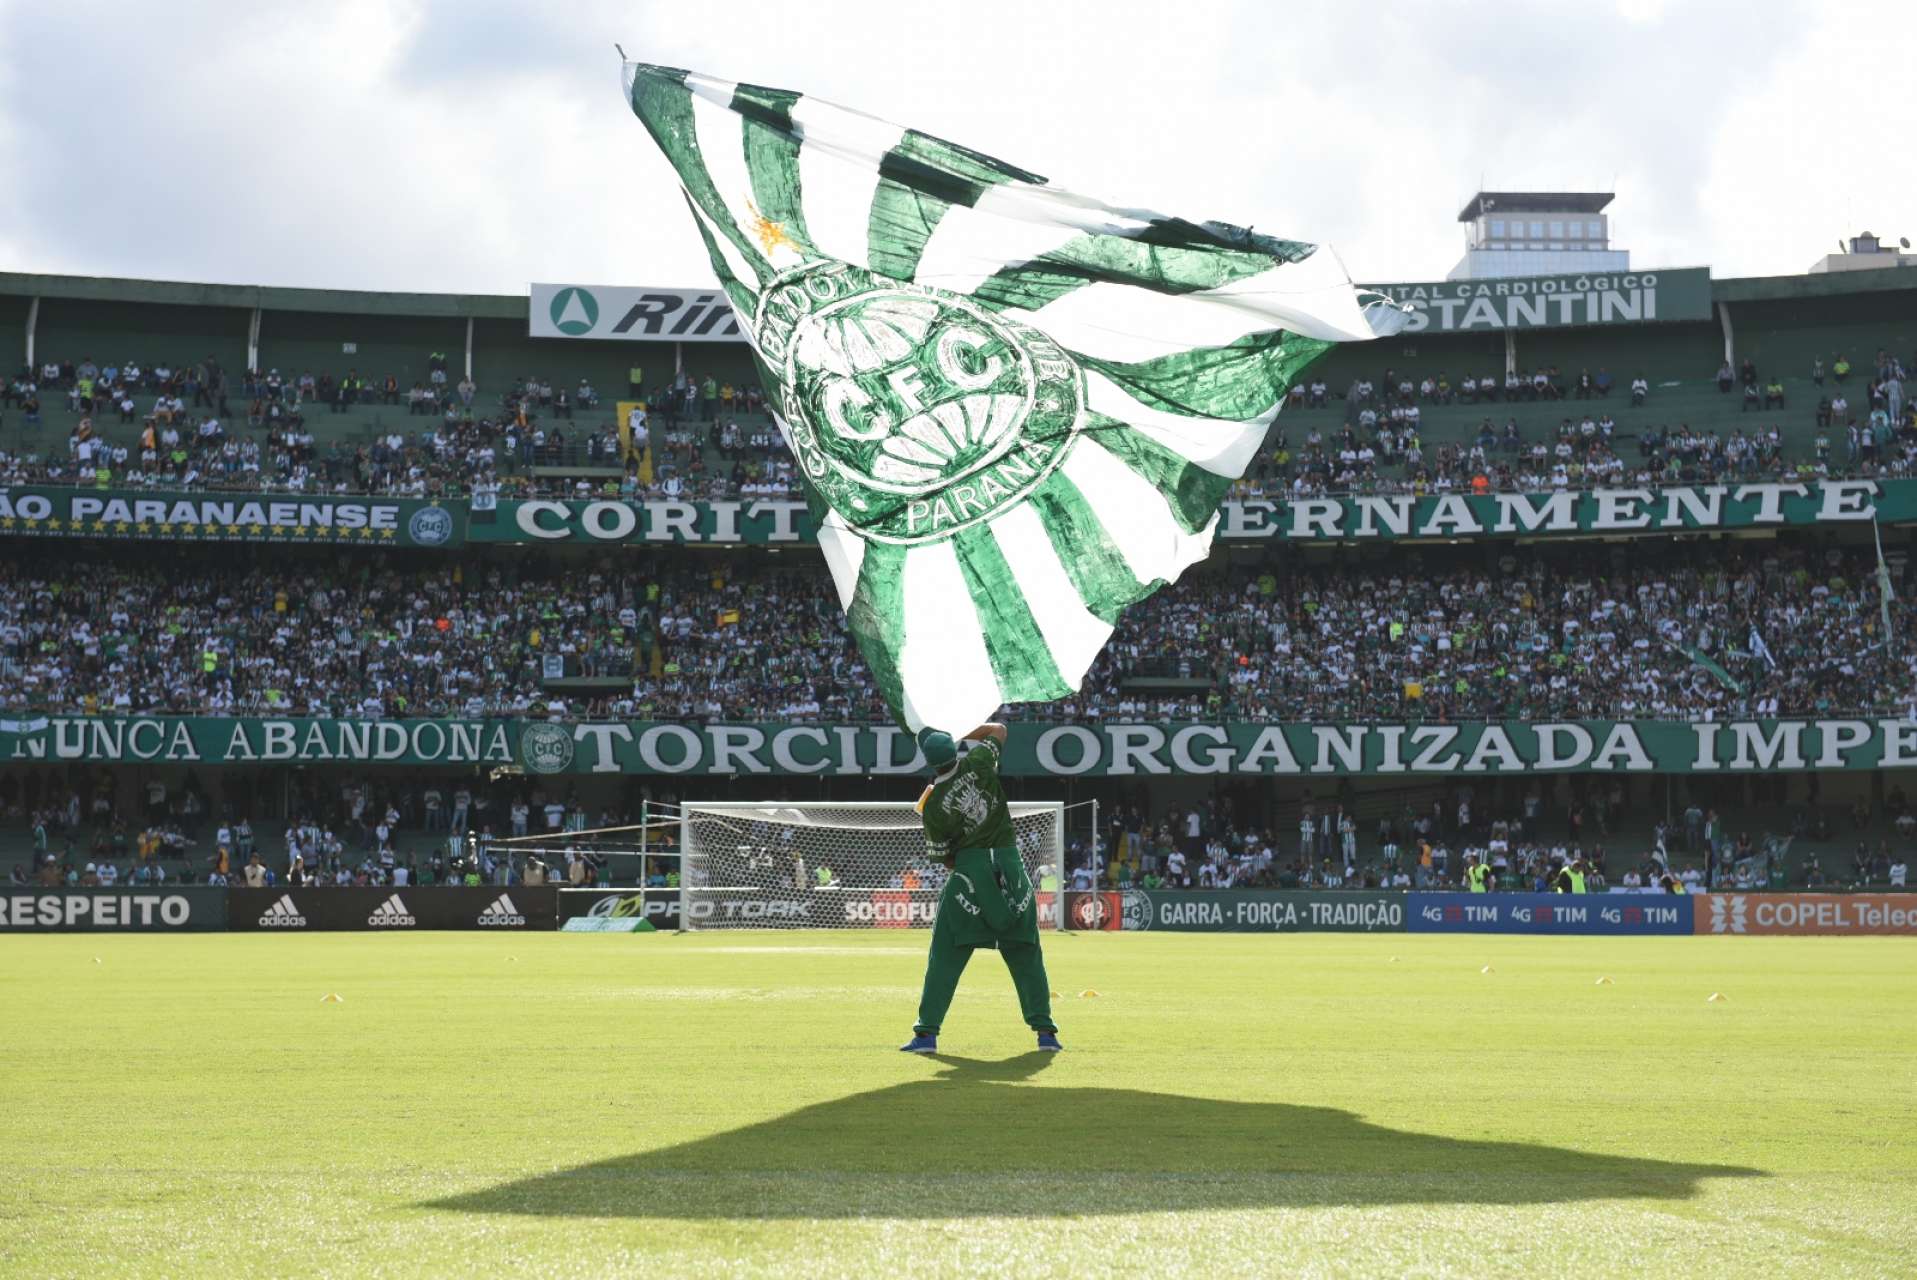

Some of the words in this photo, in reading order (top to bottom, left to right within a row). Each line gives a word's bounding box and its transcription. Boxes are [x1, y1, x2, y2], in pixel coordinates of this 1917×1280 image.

[1456, 274, 1657, 298] CARDIOLÓGICO
[611, 294, 741, 335] Rin
[1400, 287, 1656, 331] STANTINI
[72, 497, 400, 530] PARANAENSE
[516, 500, 809, 541] CORIT
[1220, 479, 1879, 538] ERNAMENTE
[223, 721, 513, 762] ABANDONA
[1036, 722, 1653, 775] ORGANIZADA
[1691, 718, 1917, 769] IMPE
[258, 914, 306, 927] adidas
[368, 914, 416, 927] adidas
[478, 914, 526, 927] adidas
[844, 902, 936, 921] SOCIOFU
[1160, 902, 1223, 925] GARRA
[1236, 902, 1298, 929] FORÇA
[1309, 899, 1401, 930] TRADIÇÃO
[1421, 904, 1442, 921] 4G
[1464, 905, 1498, 922] TIM
[1511, 905, 1531, 922] 4G
[1553, 906, 1587, 923] TIM
[1600, 906, 1621, 923] 4G
[1643, 907, 1678, 924] TIM
[1755, 902, 1851, 926] COPEL
